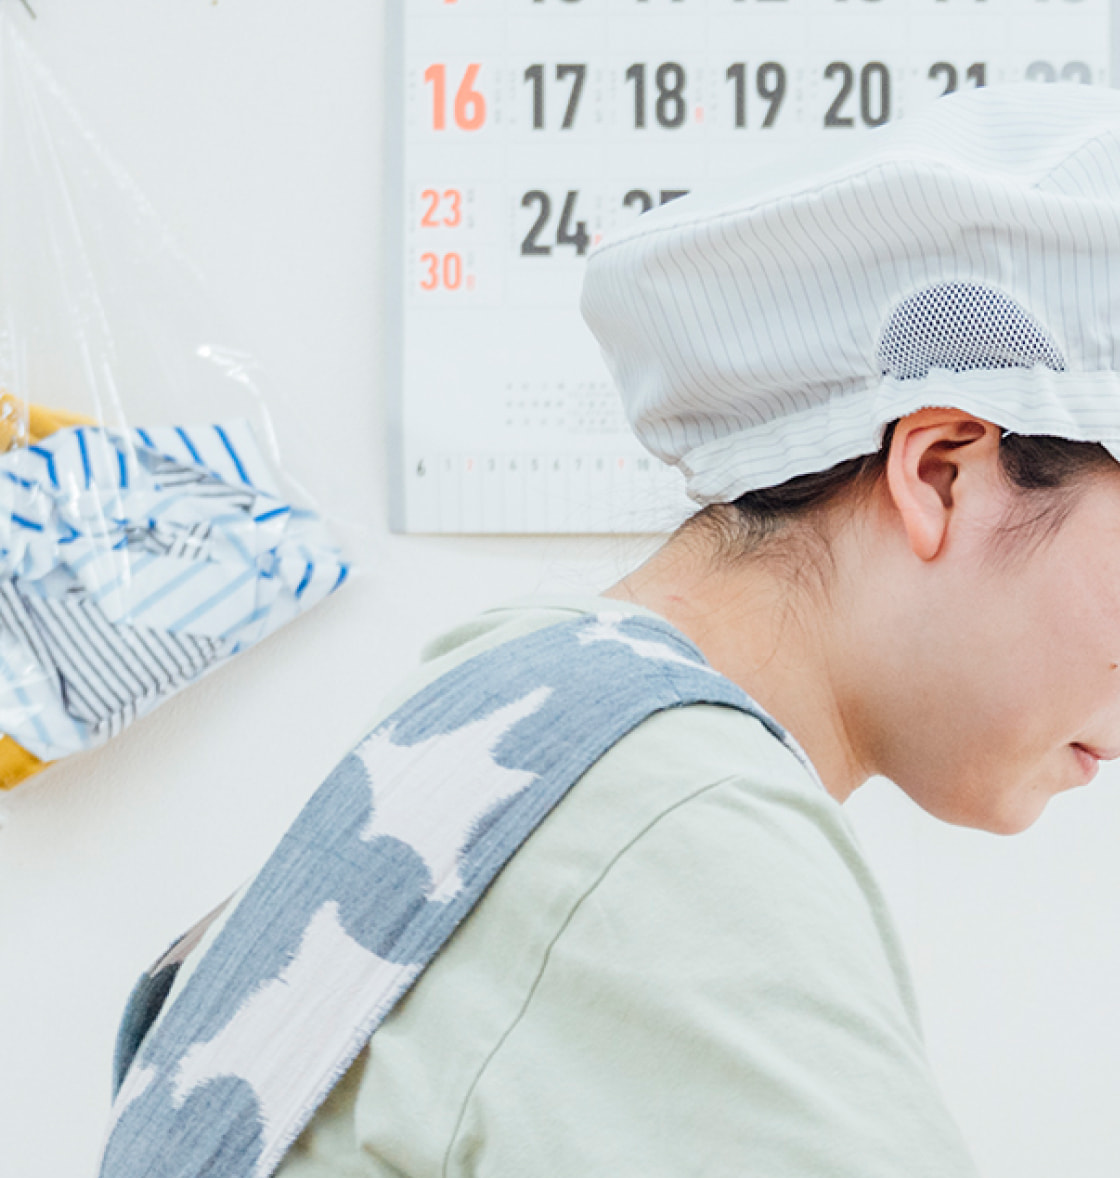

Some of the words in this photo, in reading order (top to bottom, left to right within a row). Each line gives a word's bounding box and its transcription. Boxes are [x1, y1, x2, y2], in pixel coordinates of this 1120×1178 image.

[424, 63, 486, 131] 16
[523, 63, 587, 130] 17
[625, 61, 686, 129] 18
[725, 61, 787, 129] 19
[824, 61, 890, 128] 20
[421, 189, 461, 228] 23
[521, 189, 590, 256] 24
[421, 252, 461, 290] 30
